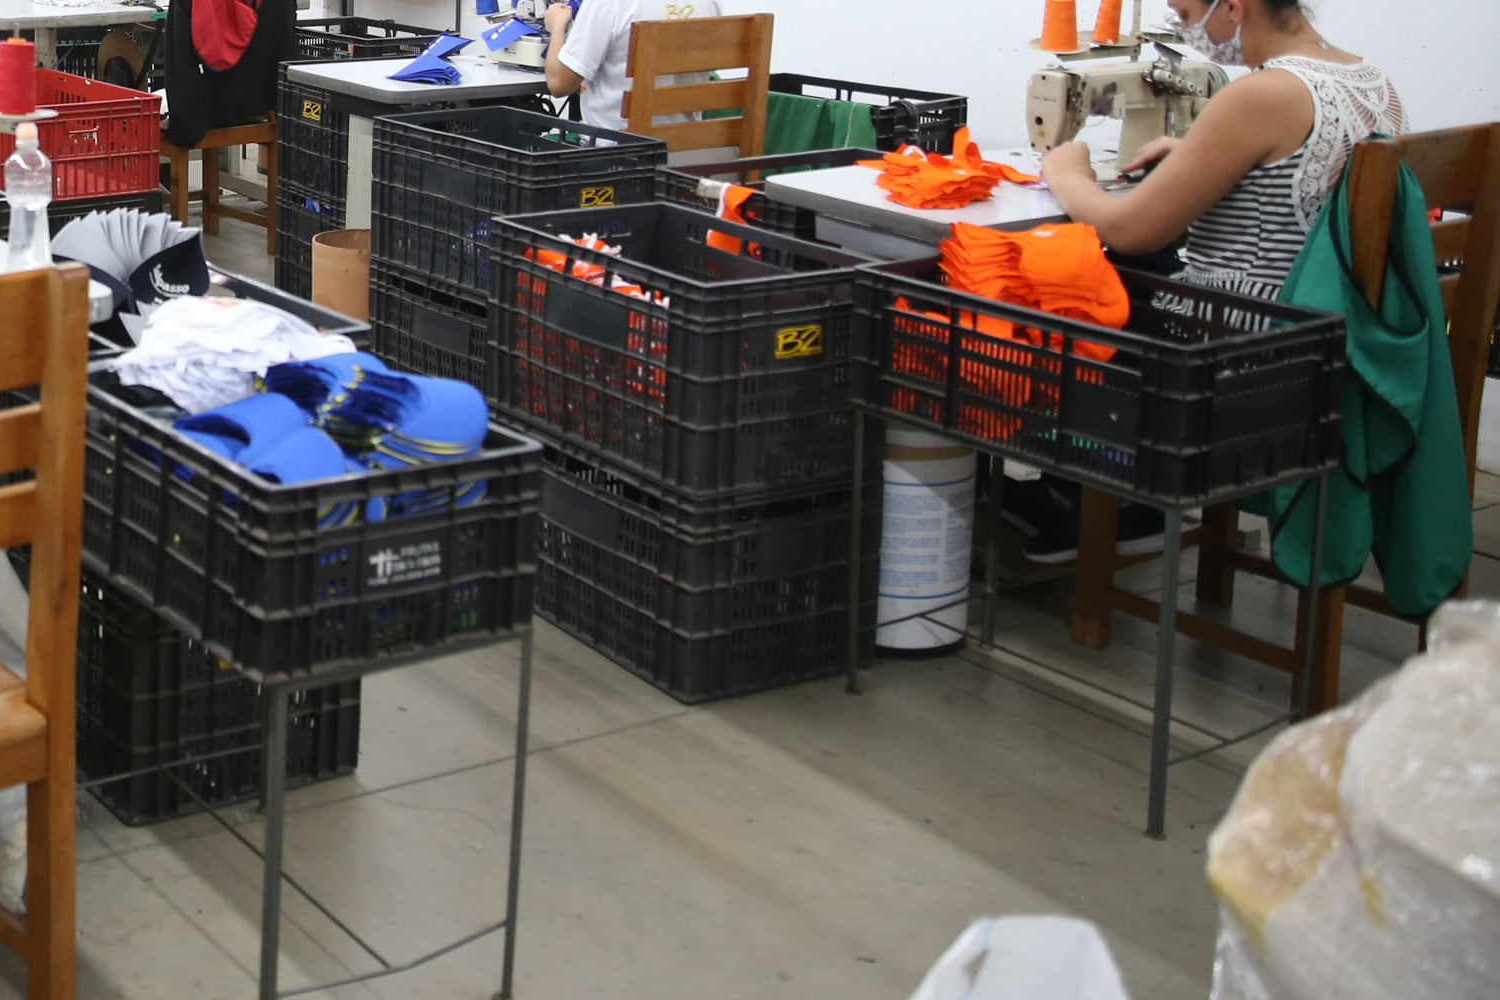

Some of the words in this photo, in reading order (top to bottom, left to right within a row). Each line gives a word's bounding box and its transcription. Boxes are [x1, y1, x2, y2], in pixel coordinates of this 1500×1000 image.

[303, 101, 321, 118] B2
[581, 188, 614, 206] B2
[776, 327, 822, 356] B2
